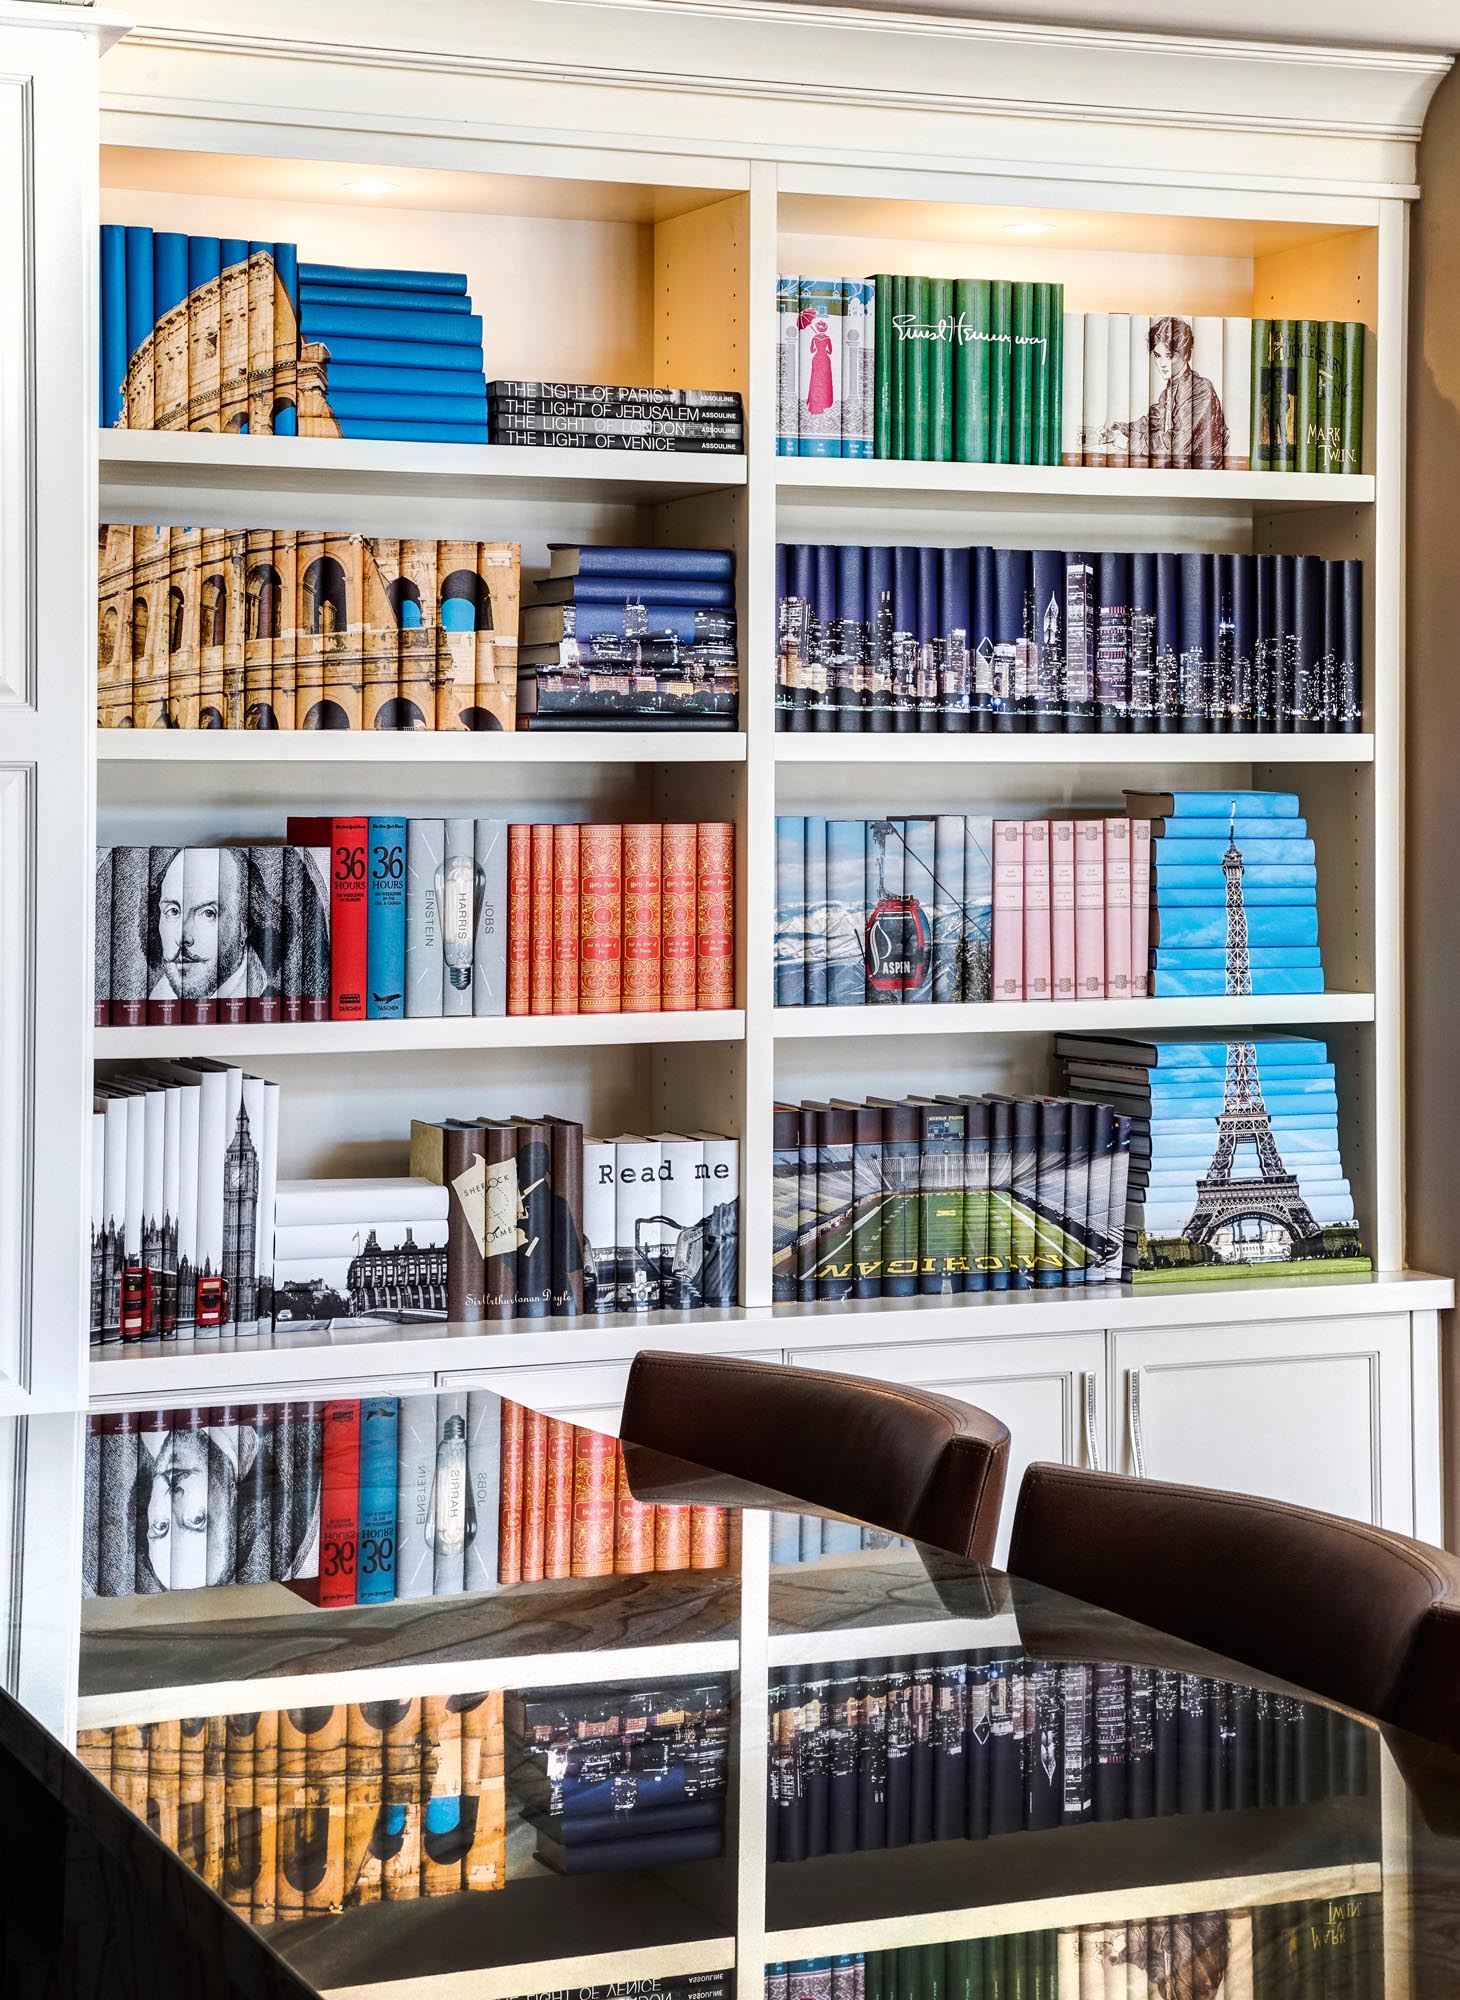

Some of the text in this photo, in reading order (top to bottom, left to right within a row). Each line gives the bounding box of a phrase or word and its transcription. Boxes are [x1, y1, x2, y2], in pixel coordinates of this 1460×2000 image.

[504, 382, 664, 404] THE LIGHT OF PARIS
[506, 400, 700, 422] THE LIGHT OF JERUSALEM
[701, 411, 736, 420] ASSOULINE
[505, 414, 686, 436] THE LIGHT OF LONDON
[701, 426, 736, 435] ASSOULINE
[1306, 424, 1341, 447] MARK
[506, 430, 676, 452] THE LIGHT OF VENICE
[701, 442, 736, 450] ASSOULINE
[335, 846, 366, 880] 36
[372, 846, 404, 879] 36
[335, 881, 366, 891] HOURS
[372, 880, 404, 890] HOURS
[425, 890, 435, 948] EINSTEIN
[458, 892, 467, 940] HARRIS
[484, 902, 494, 934] JOBS
[882, 961, 910, 974] ASPEN
[599, 1160, 730, 1184] Read me
[464, 1293, 482, 1306] Sir
